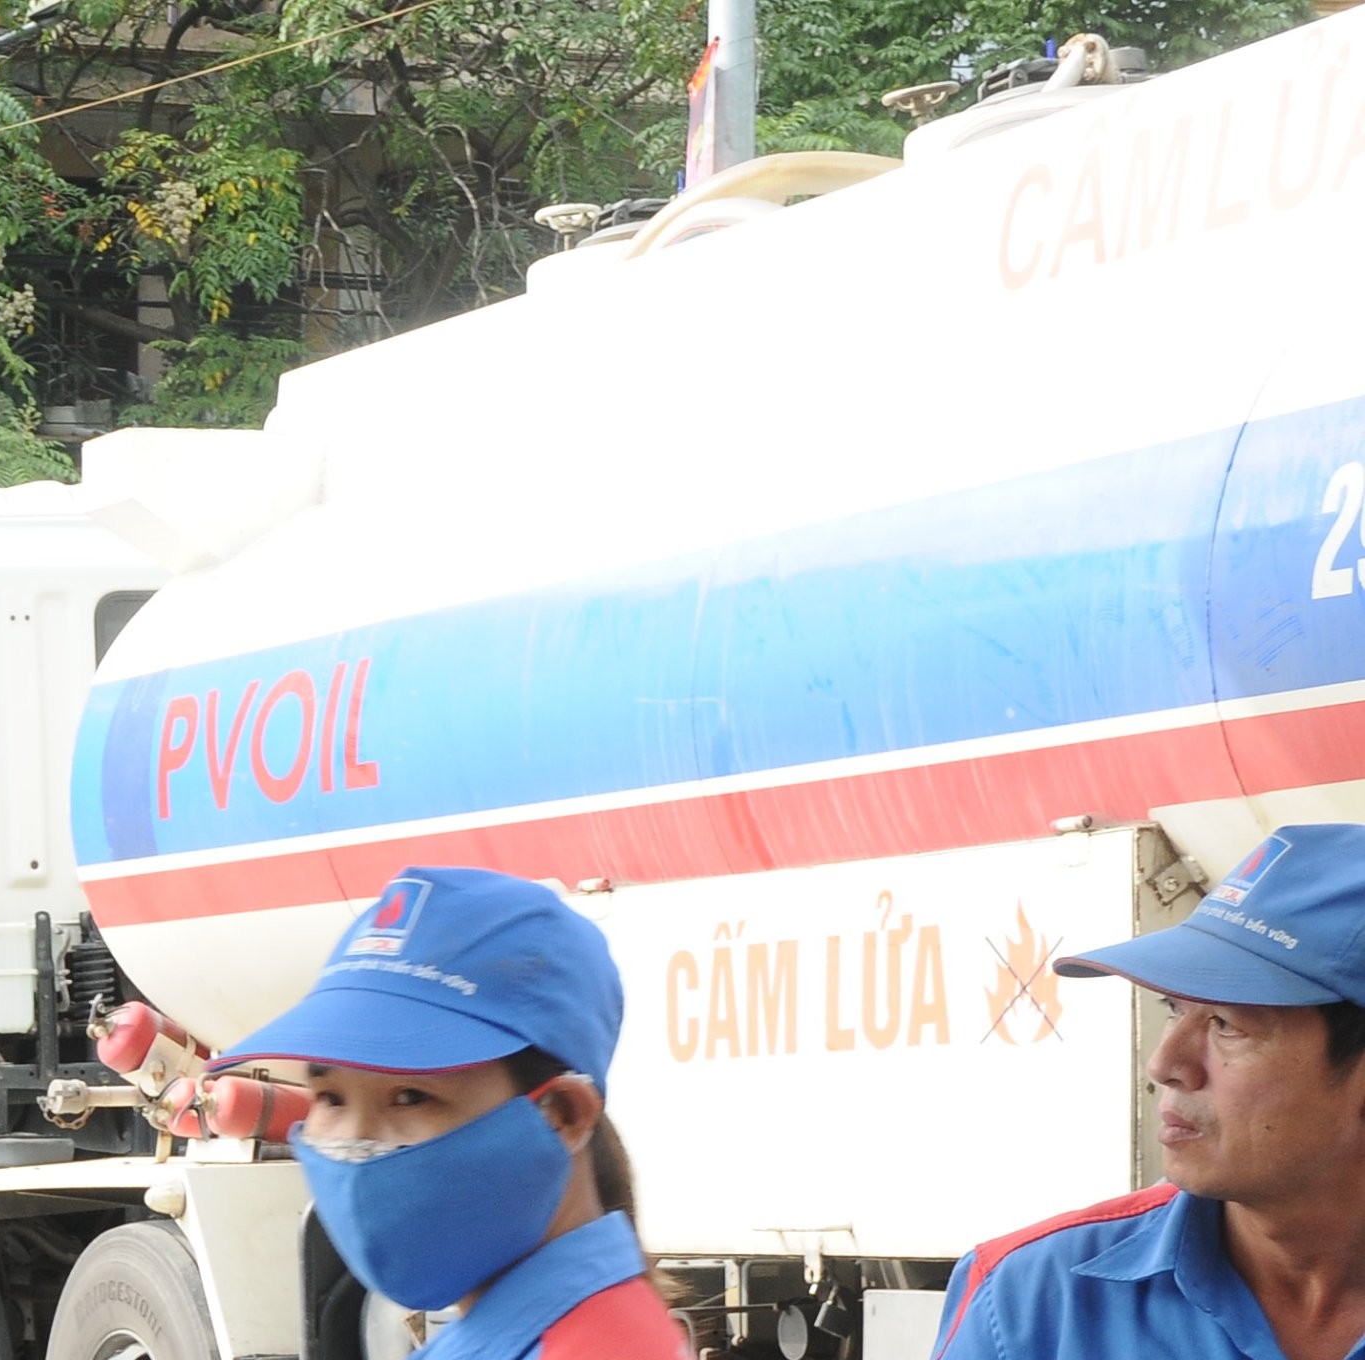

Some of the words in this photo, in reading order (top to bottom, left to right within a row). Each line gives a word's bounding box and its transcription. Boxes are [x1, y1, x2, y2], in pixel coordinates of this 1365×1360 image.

[1311, 460, 1365, 600] 2
[157, 656, 380, 821] PVOIL
[665, 920, 799, 1063] CẤM
[824, 889, 952, 1053] LỬA
